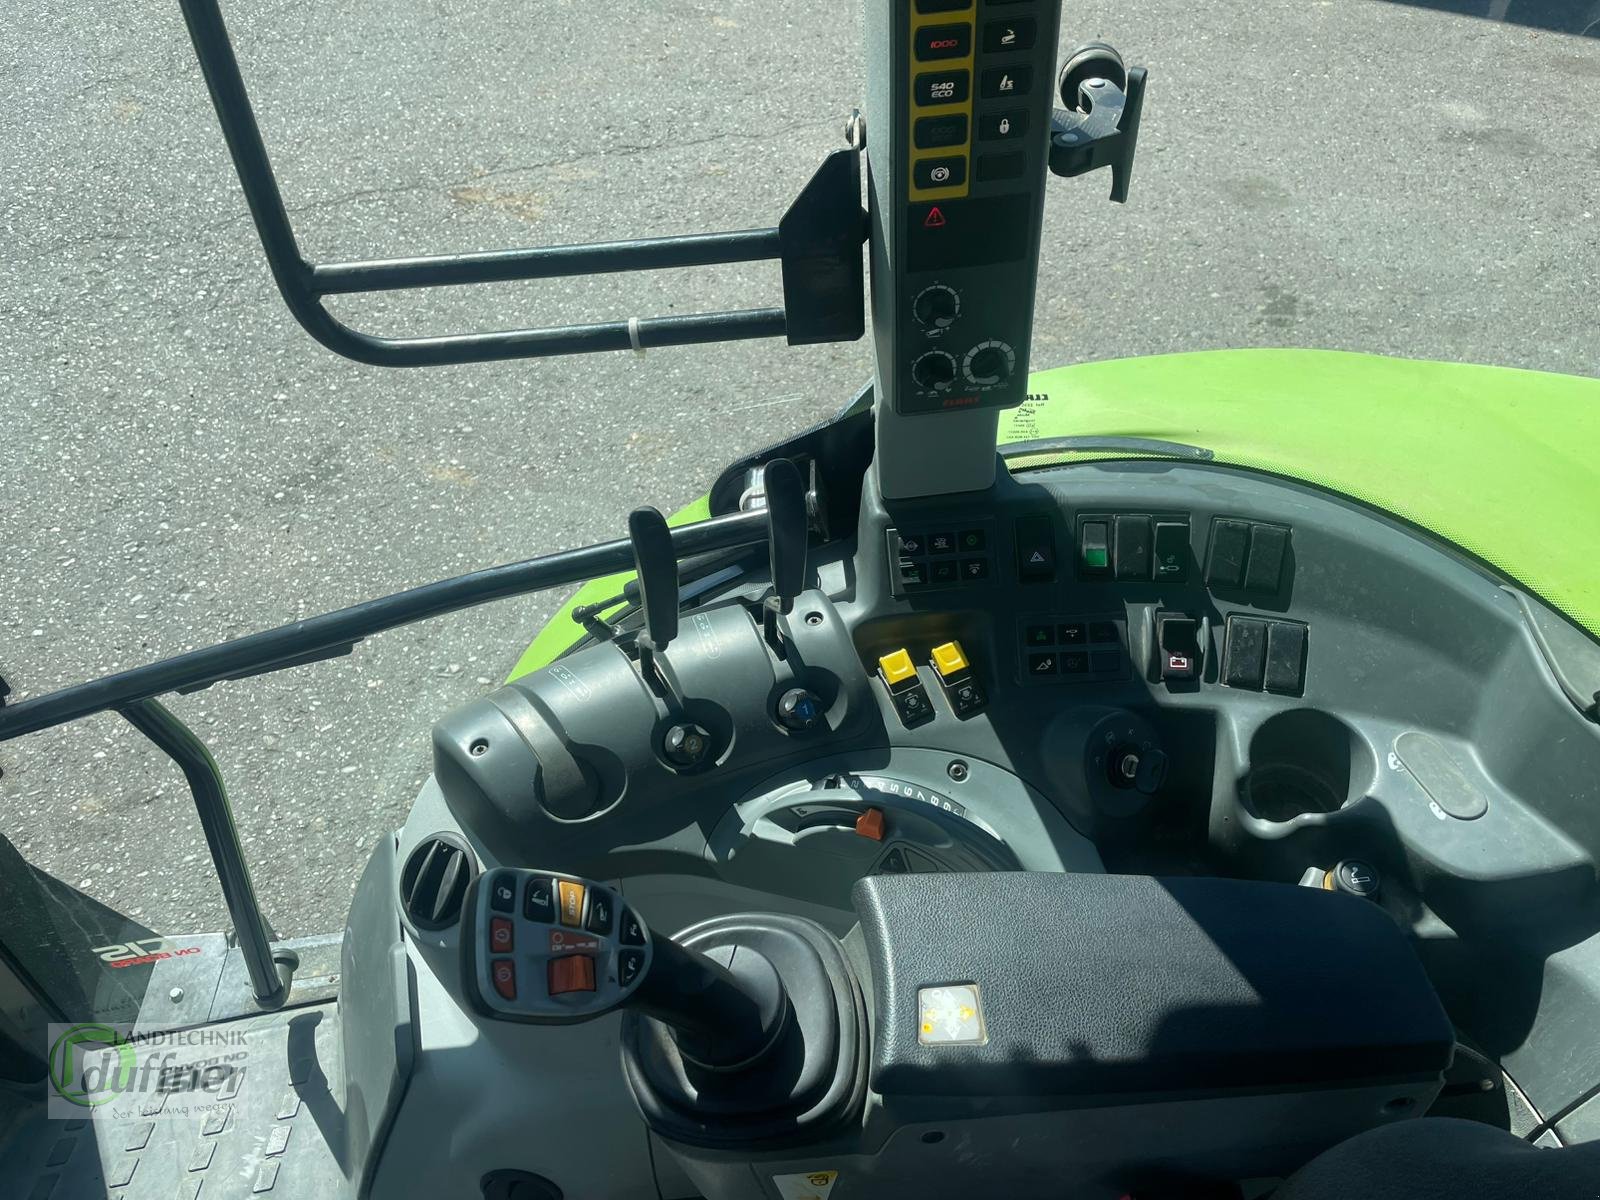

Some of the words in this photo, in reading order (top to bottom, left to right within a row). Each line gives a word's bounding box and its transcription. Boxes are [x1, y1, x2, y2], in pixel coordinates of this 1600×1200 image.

[930, 40, 958, 48] 1000
[930, 82, 954, 91] 540
[930, 90, 953, 98] ECO
[689, 738, 698, 750] 2
